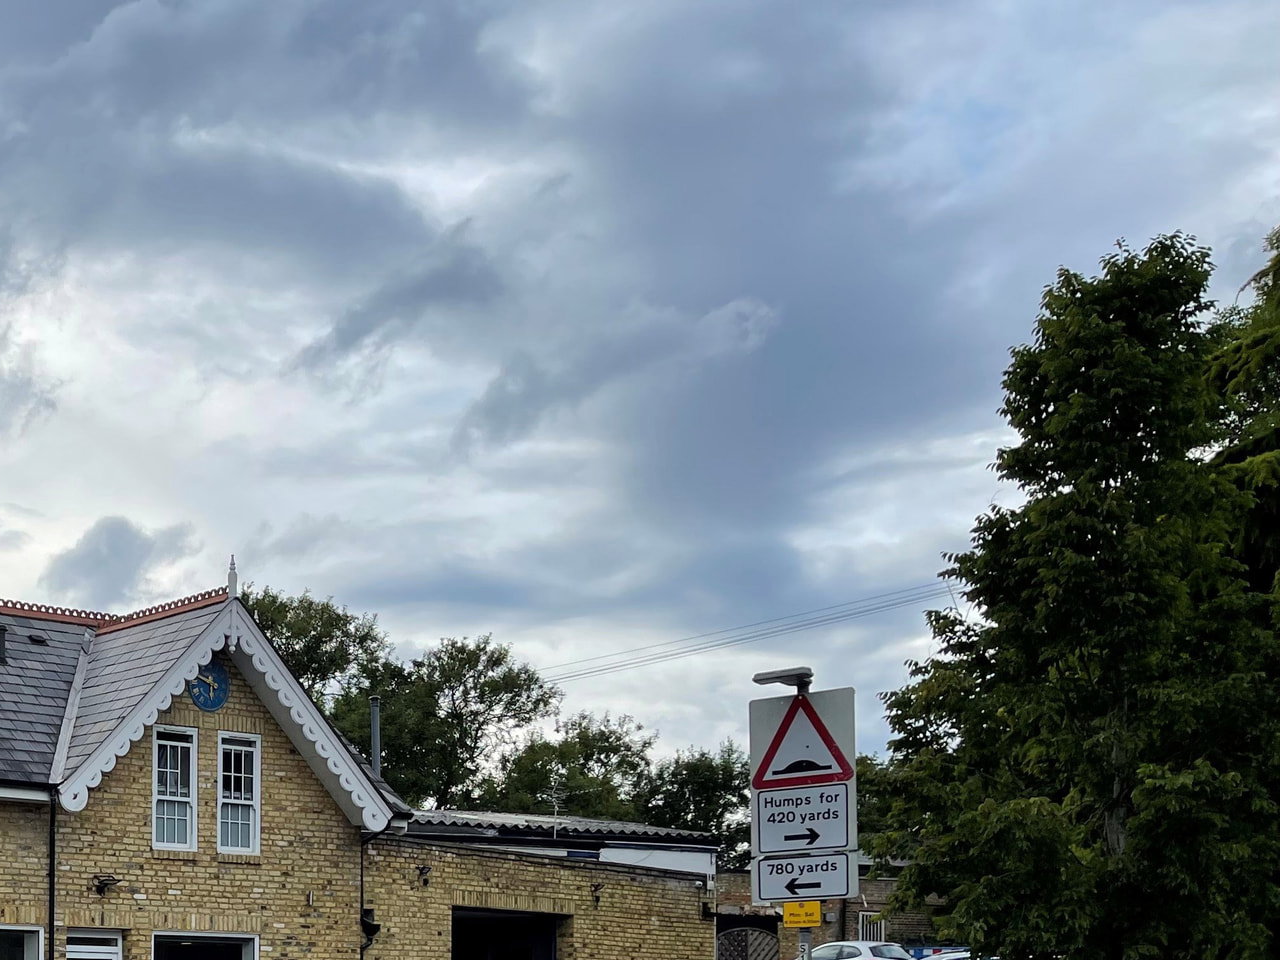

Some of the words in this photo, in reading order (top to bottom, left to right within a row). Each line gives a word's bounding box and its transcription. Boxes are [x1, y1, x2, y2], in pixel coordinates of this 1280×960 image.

[764, 796, 812, 808] Humps
[819, 792, 840, 804] for
[767, 811, 796, 824] 420
[799, 808, 839, 824] yards
[767, 862, 794, 875] 780
[798, 860, 838, 876] yards
